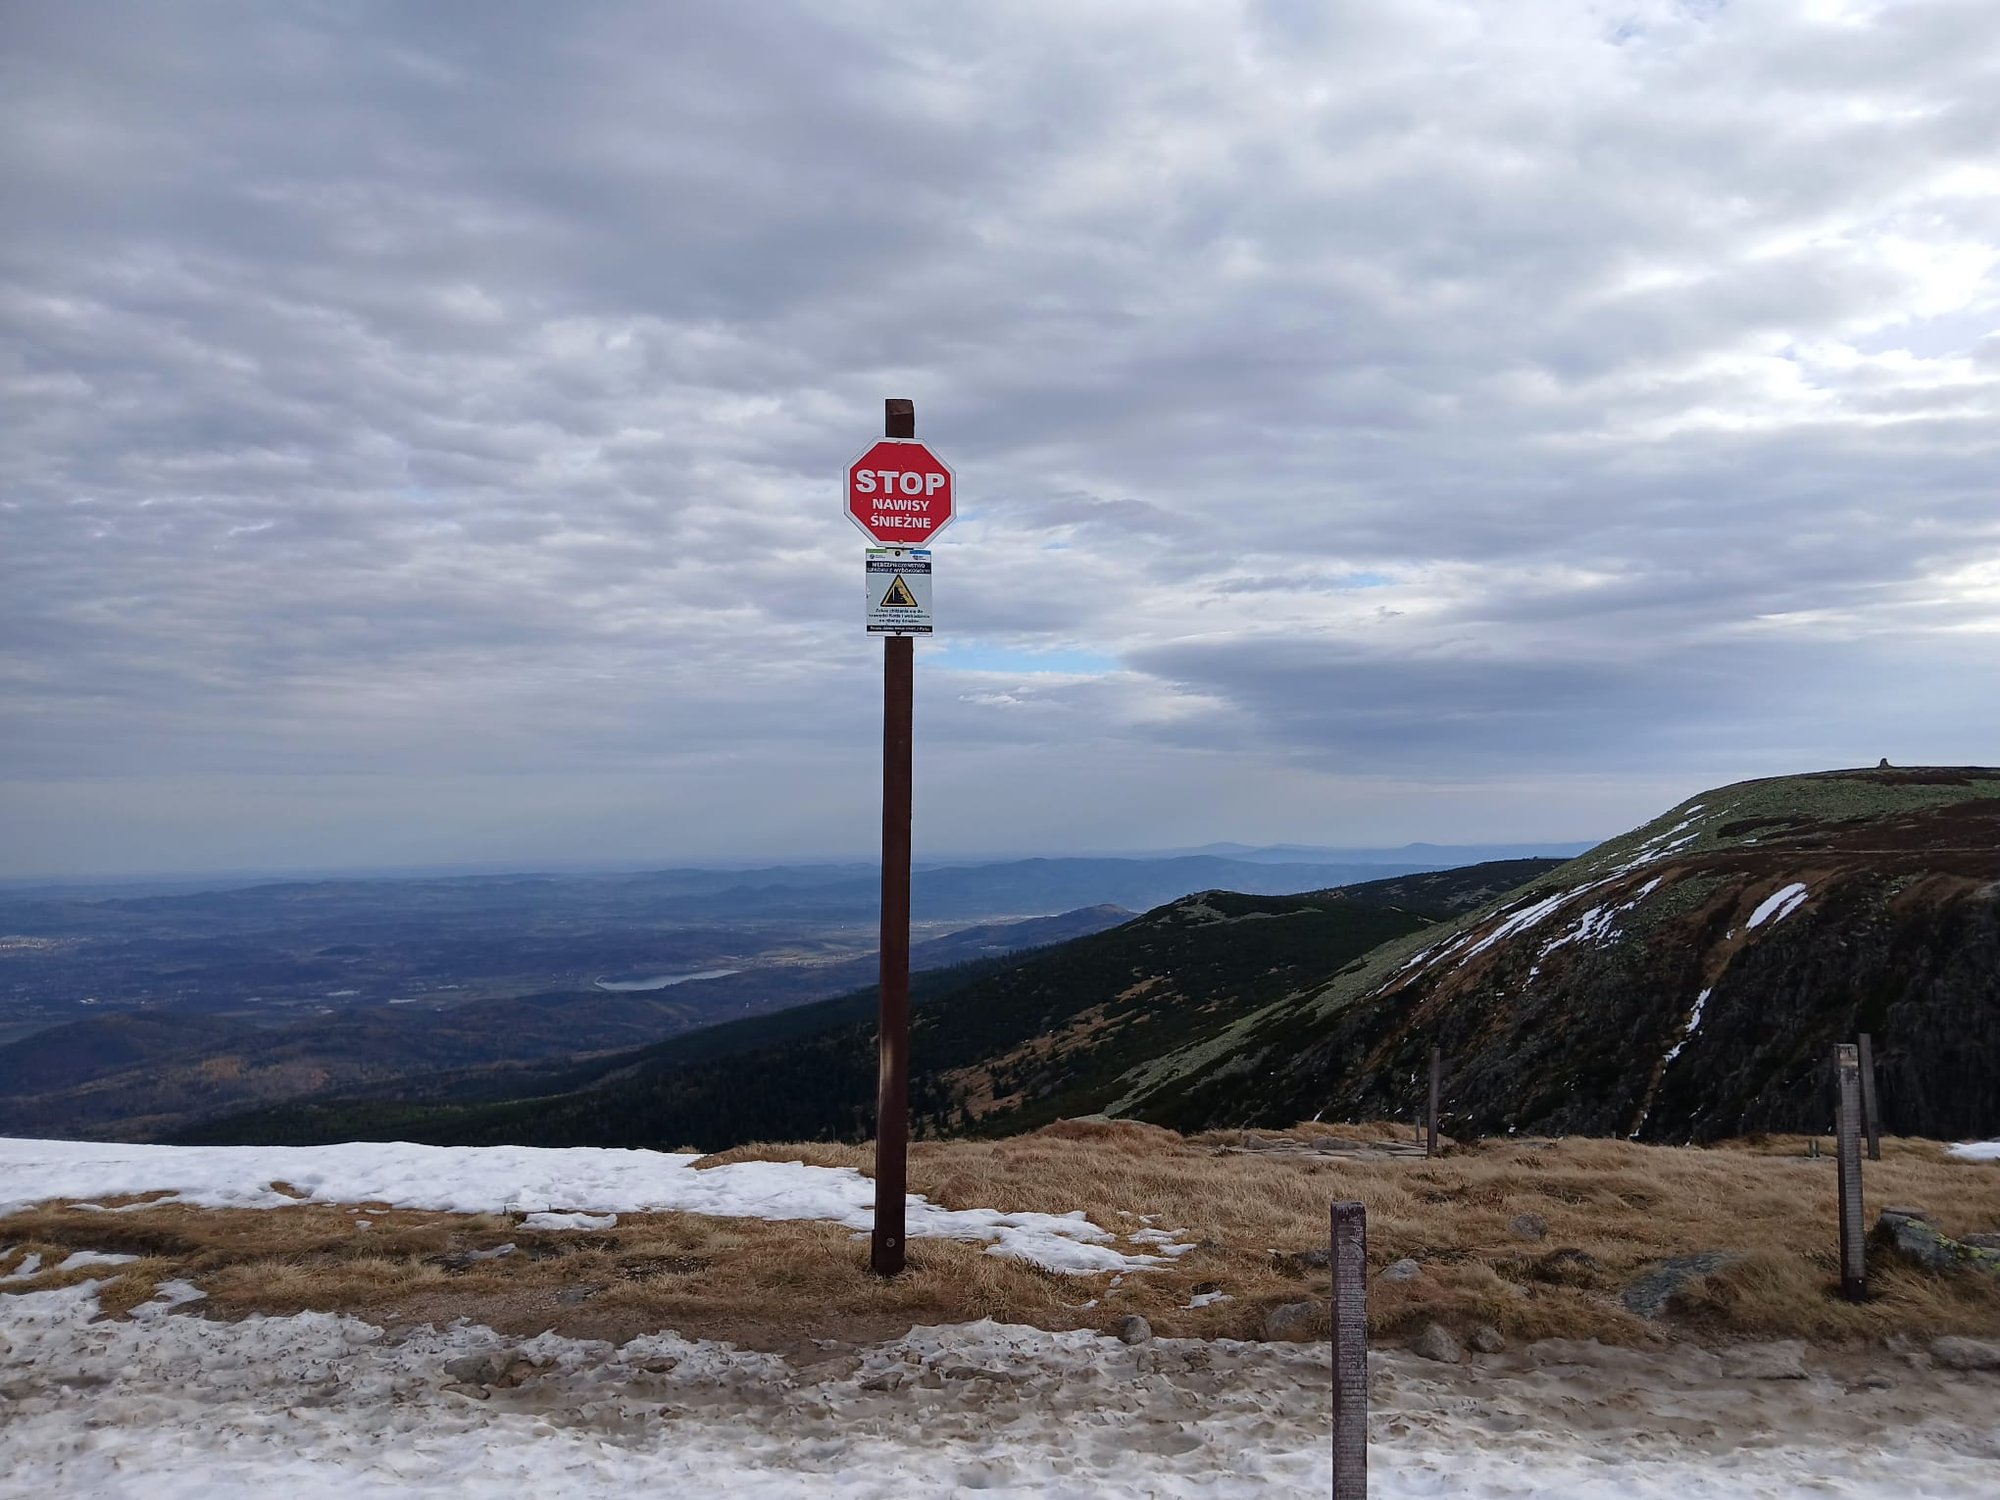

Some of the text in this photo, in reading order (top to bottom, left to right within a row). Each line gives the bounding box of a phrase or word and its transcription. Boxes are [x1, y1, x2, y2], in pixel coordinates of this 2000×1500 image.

[855, 469, 946, 496] STOP
[872, 498, 930, 512] NAWISY
[870, 512, 932, 529] ŚNIEŻNE
